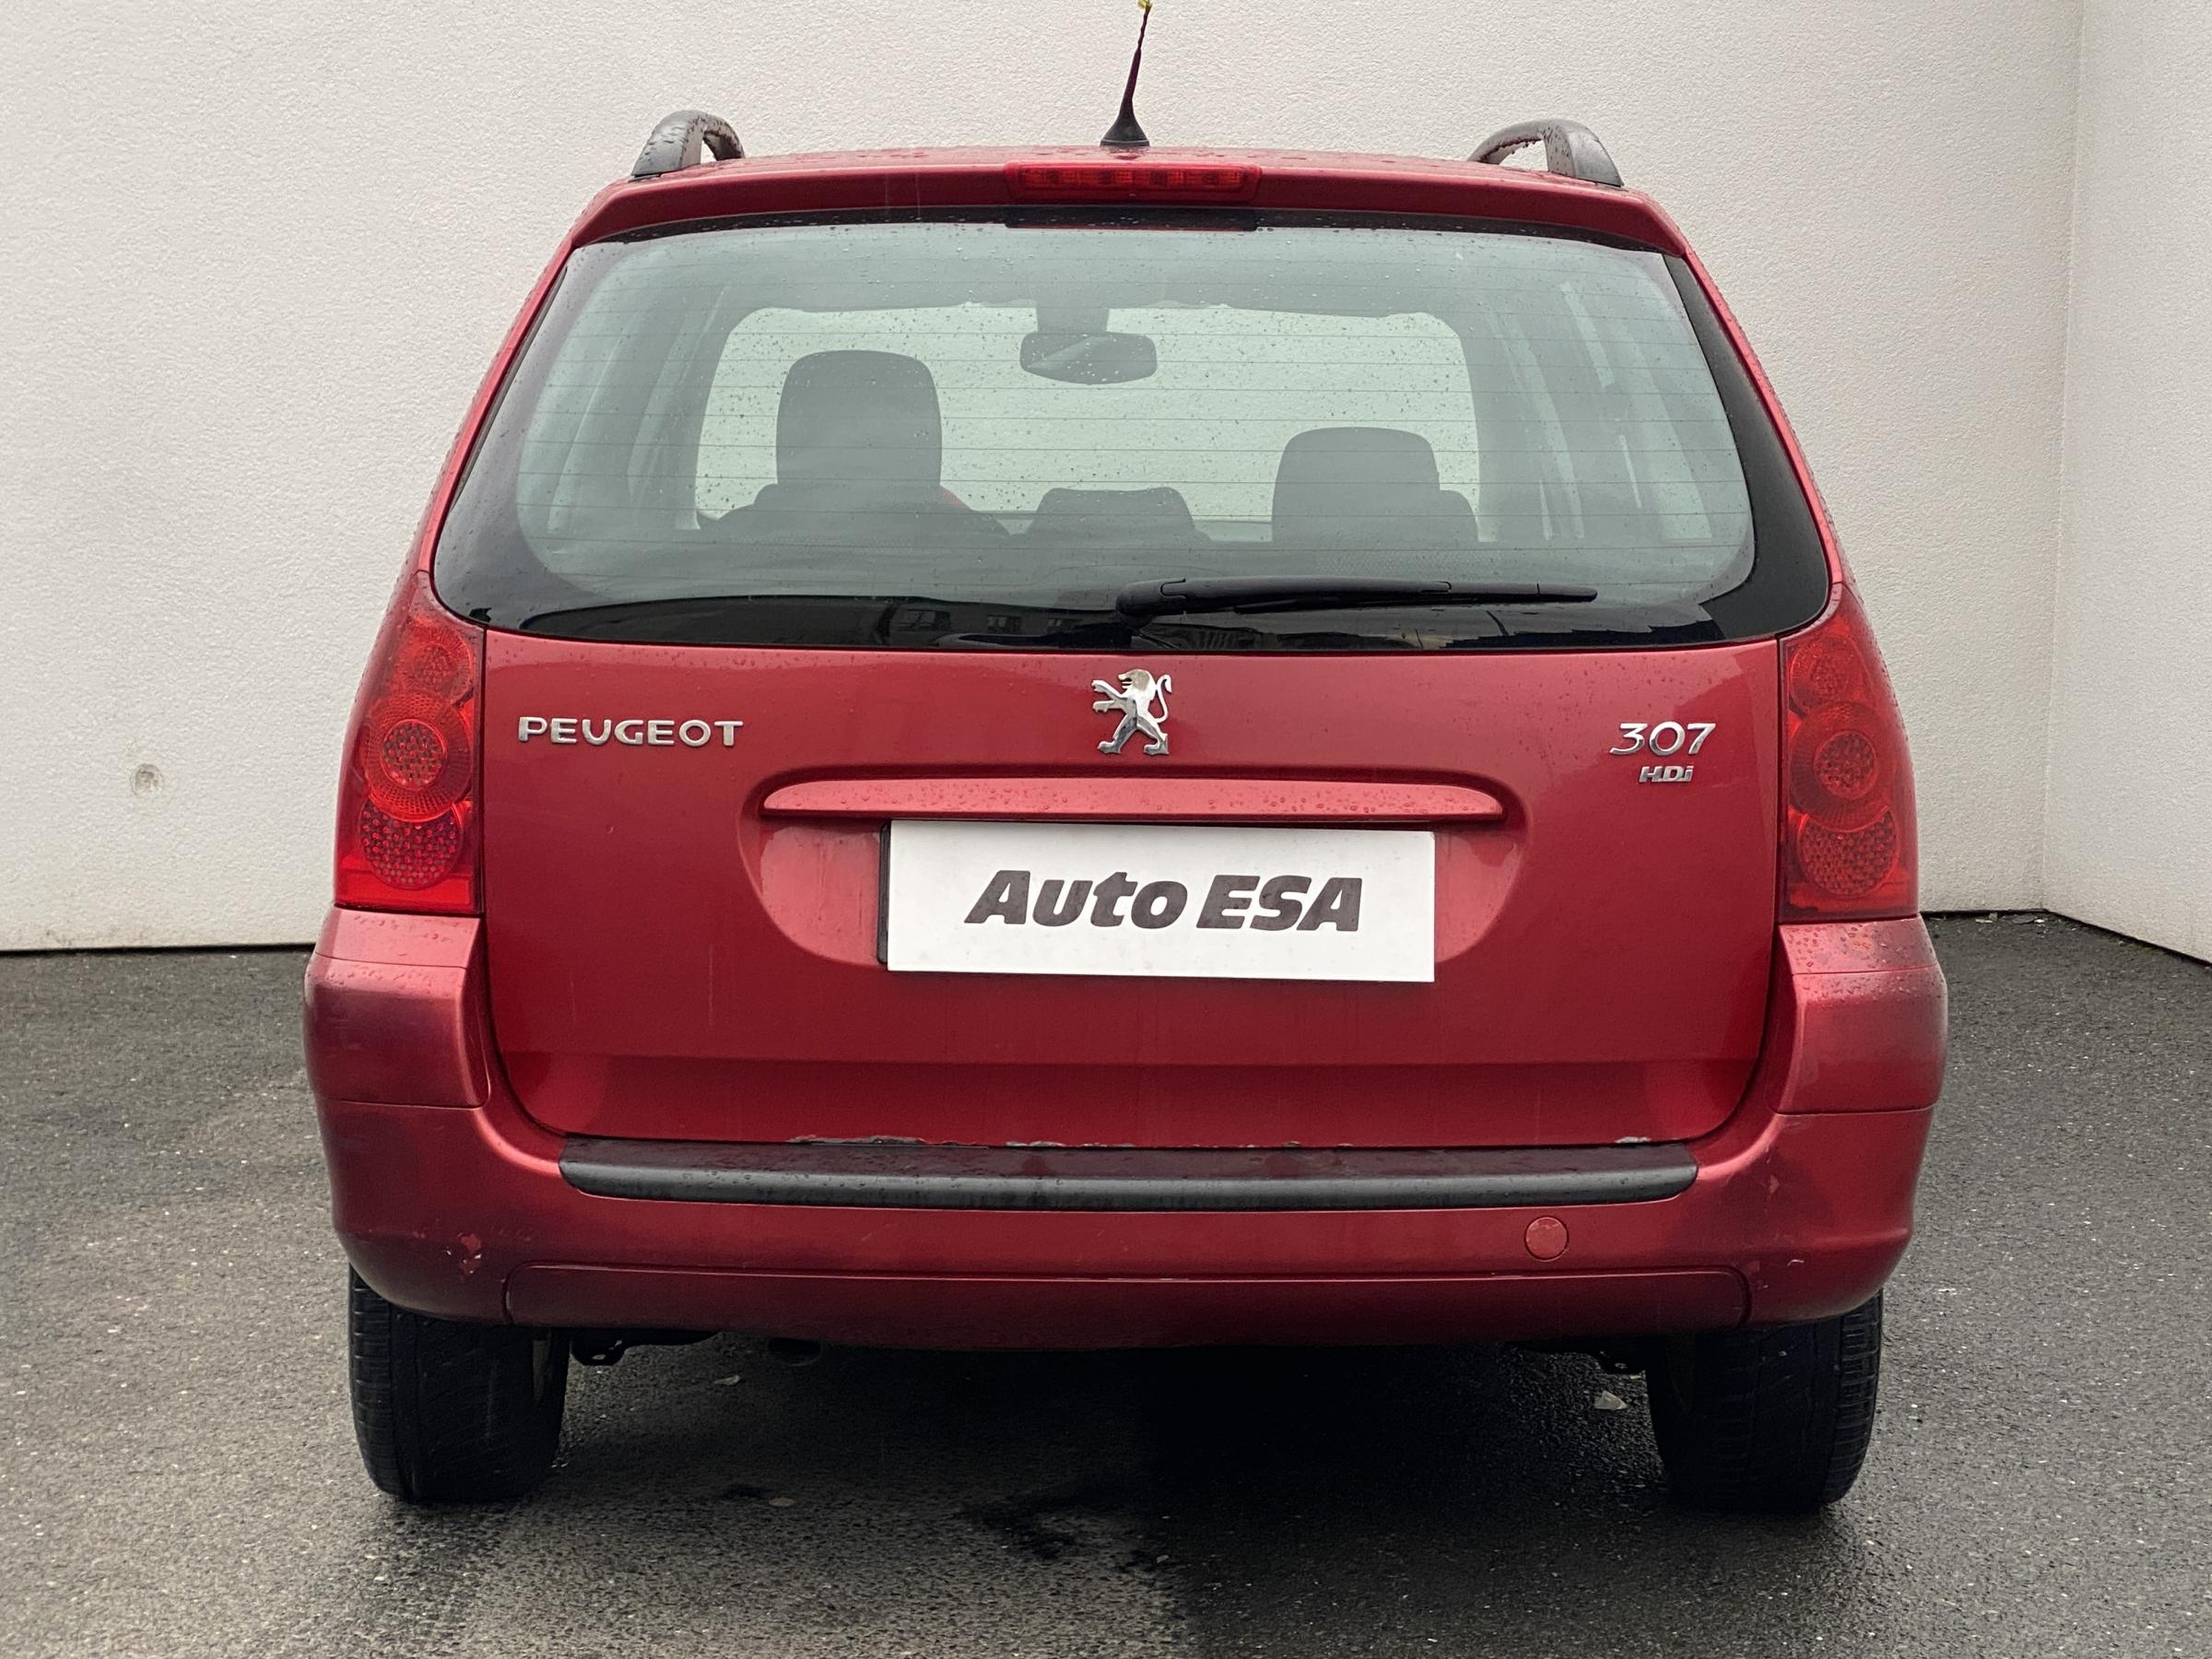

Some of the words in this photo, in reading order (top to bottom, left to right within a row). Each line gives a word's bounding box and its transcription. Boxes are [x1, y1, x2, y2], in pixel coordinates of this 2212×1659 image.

[518, 716, 743, 747] PEUGEOT
[1609, 722, 1716, 756] 307
[1639, 766, 1694, 782] HDi
[964, 870, 1188, 929] Auto
[1196, 875, 1362, 932] ESA
